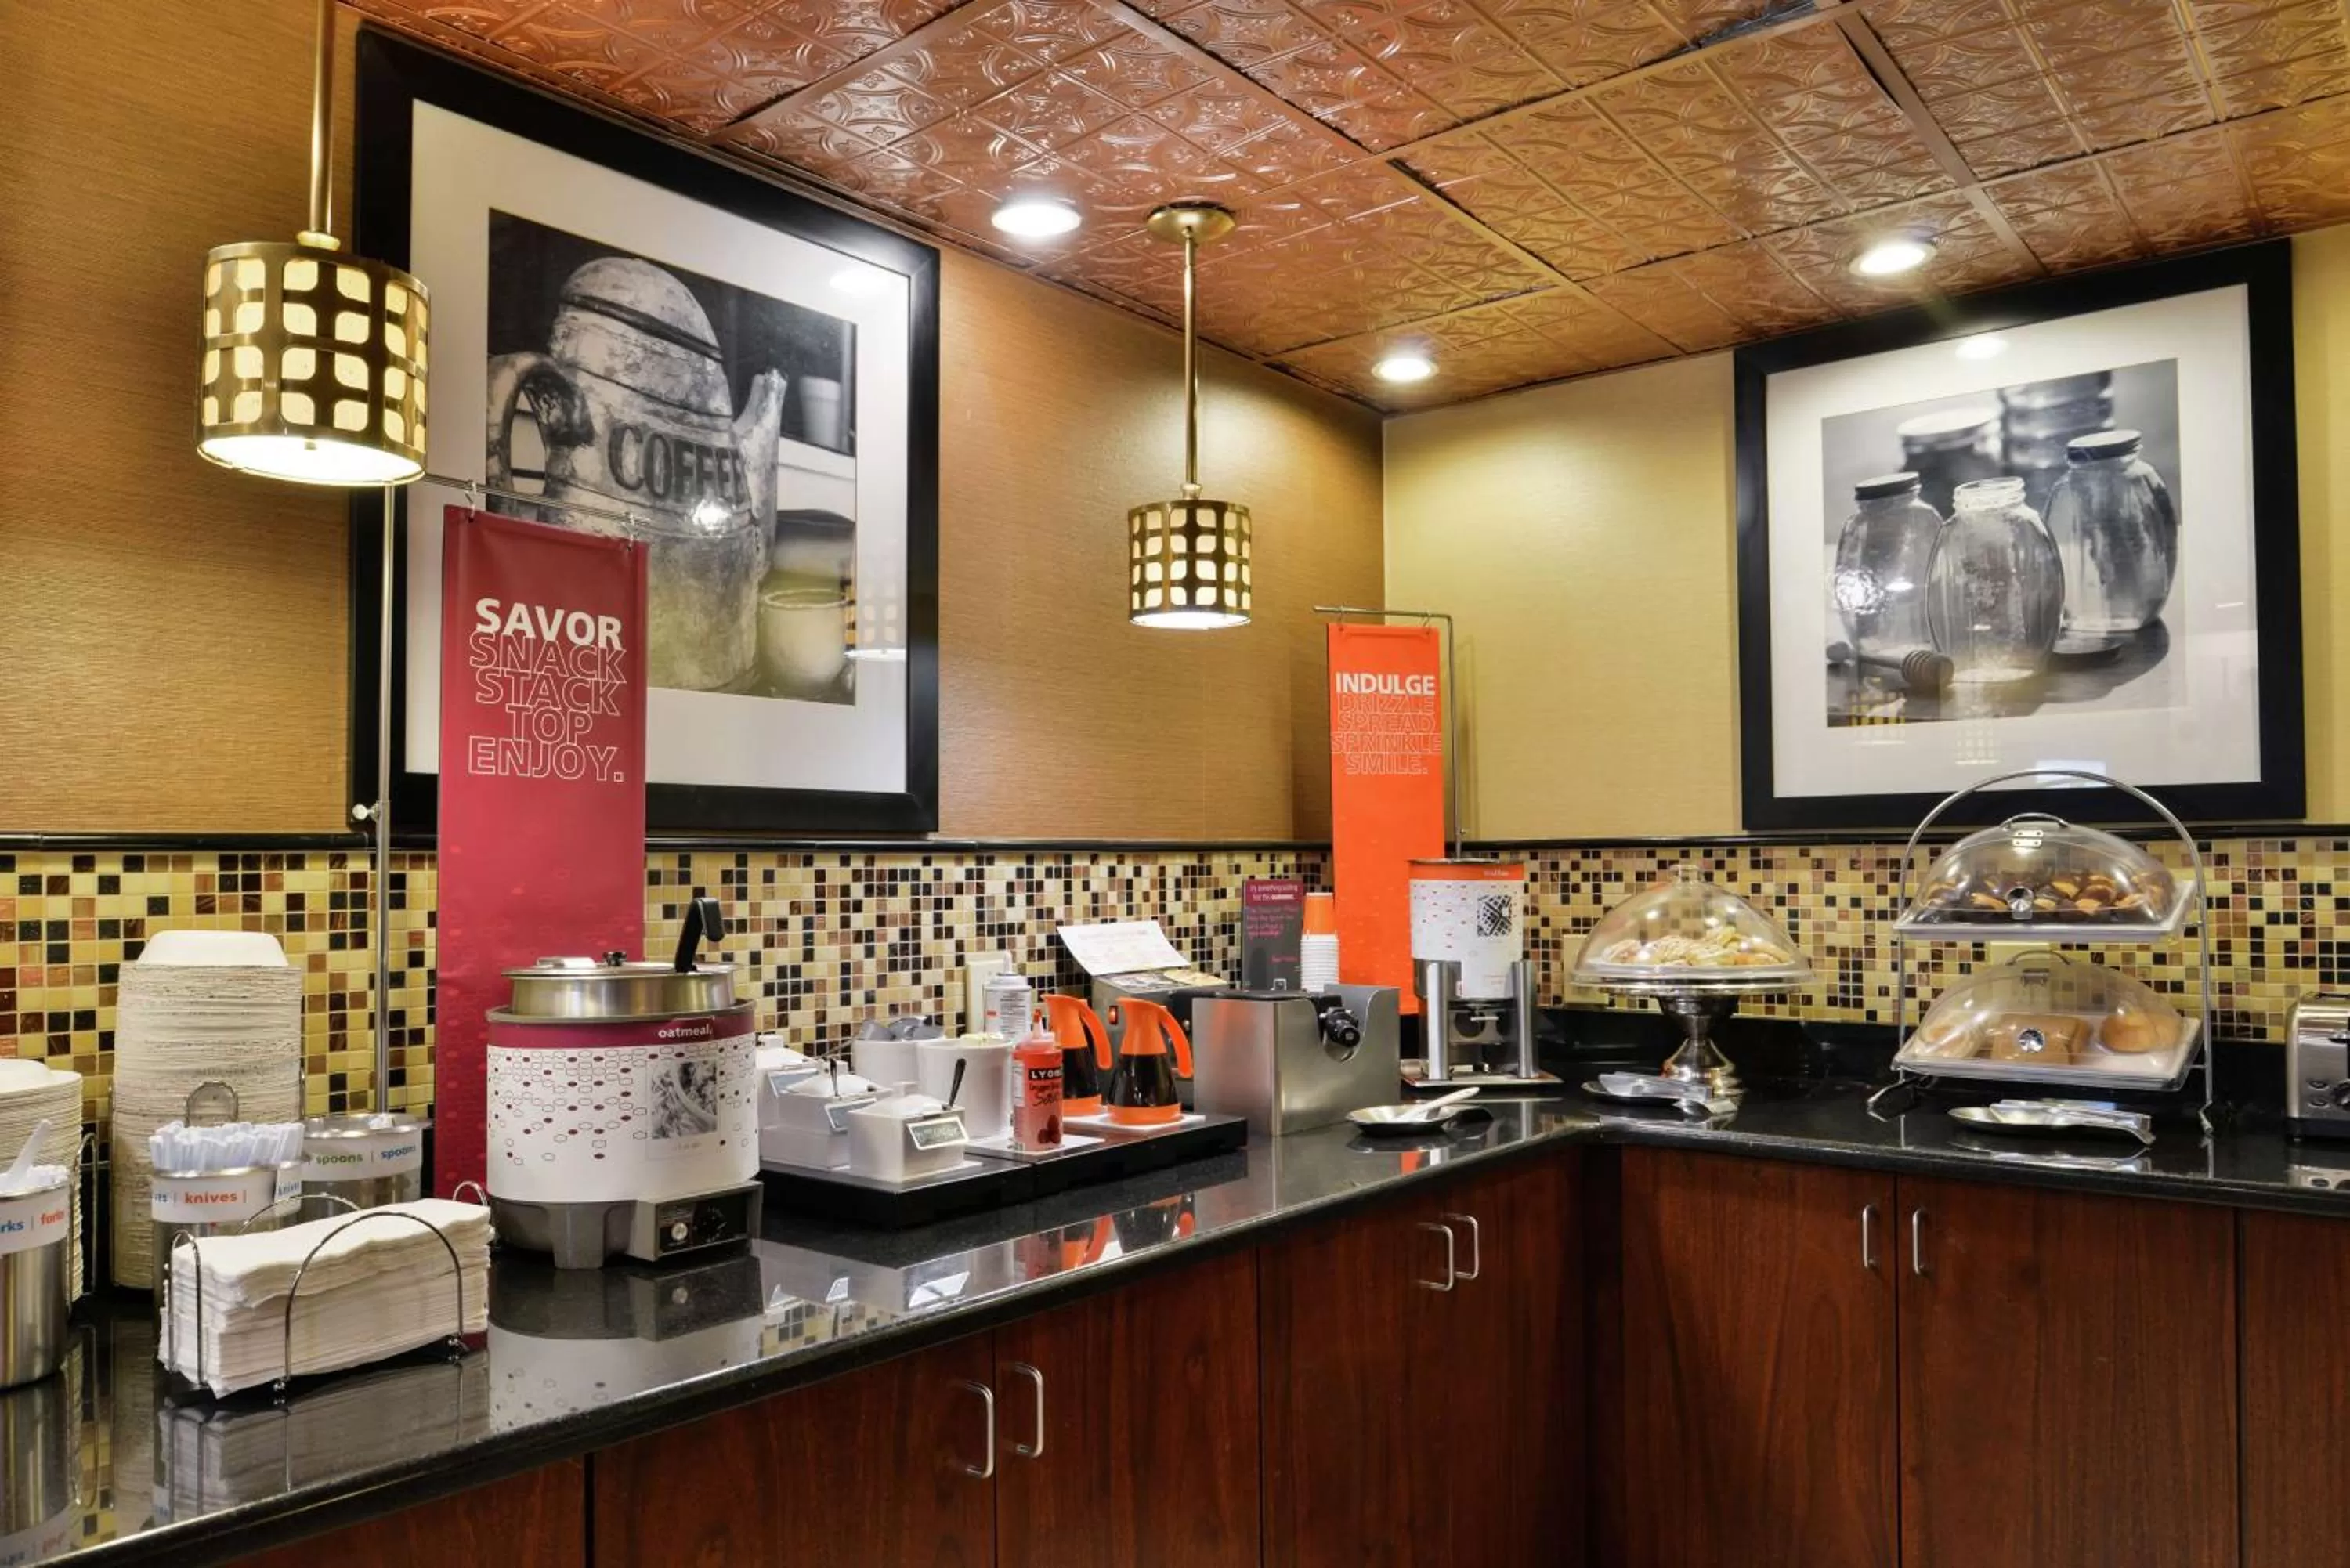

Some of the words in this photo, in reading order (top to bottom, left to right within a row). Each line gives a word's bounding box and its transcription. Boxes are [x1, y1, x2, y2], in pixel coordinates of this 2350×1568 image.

[475, 598, 622, 652] SAVOR
[469, 630, 627, 684] SNACK
[475, 666, 620, 717] STACK
[1335, 671, 1436, 696] INDULGE
[505, 704, 593, 746] TOP
[1337, 710, 1437, 734] SPREAD
[1329, 730, 1442, 755] SPRINKLE
[468, 735, 624, 783] ENJOY.
[1345, 752, 1430, 775] SMILE.
[316, 1154, 364, 1166] spoons
[184, 1190, 238, 1204] knives
